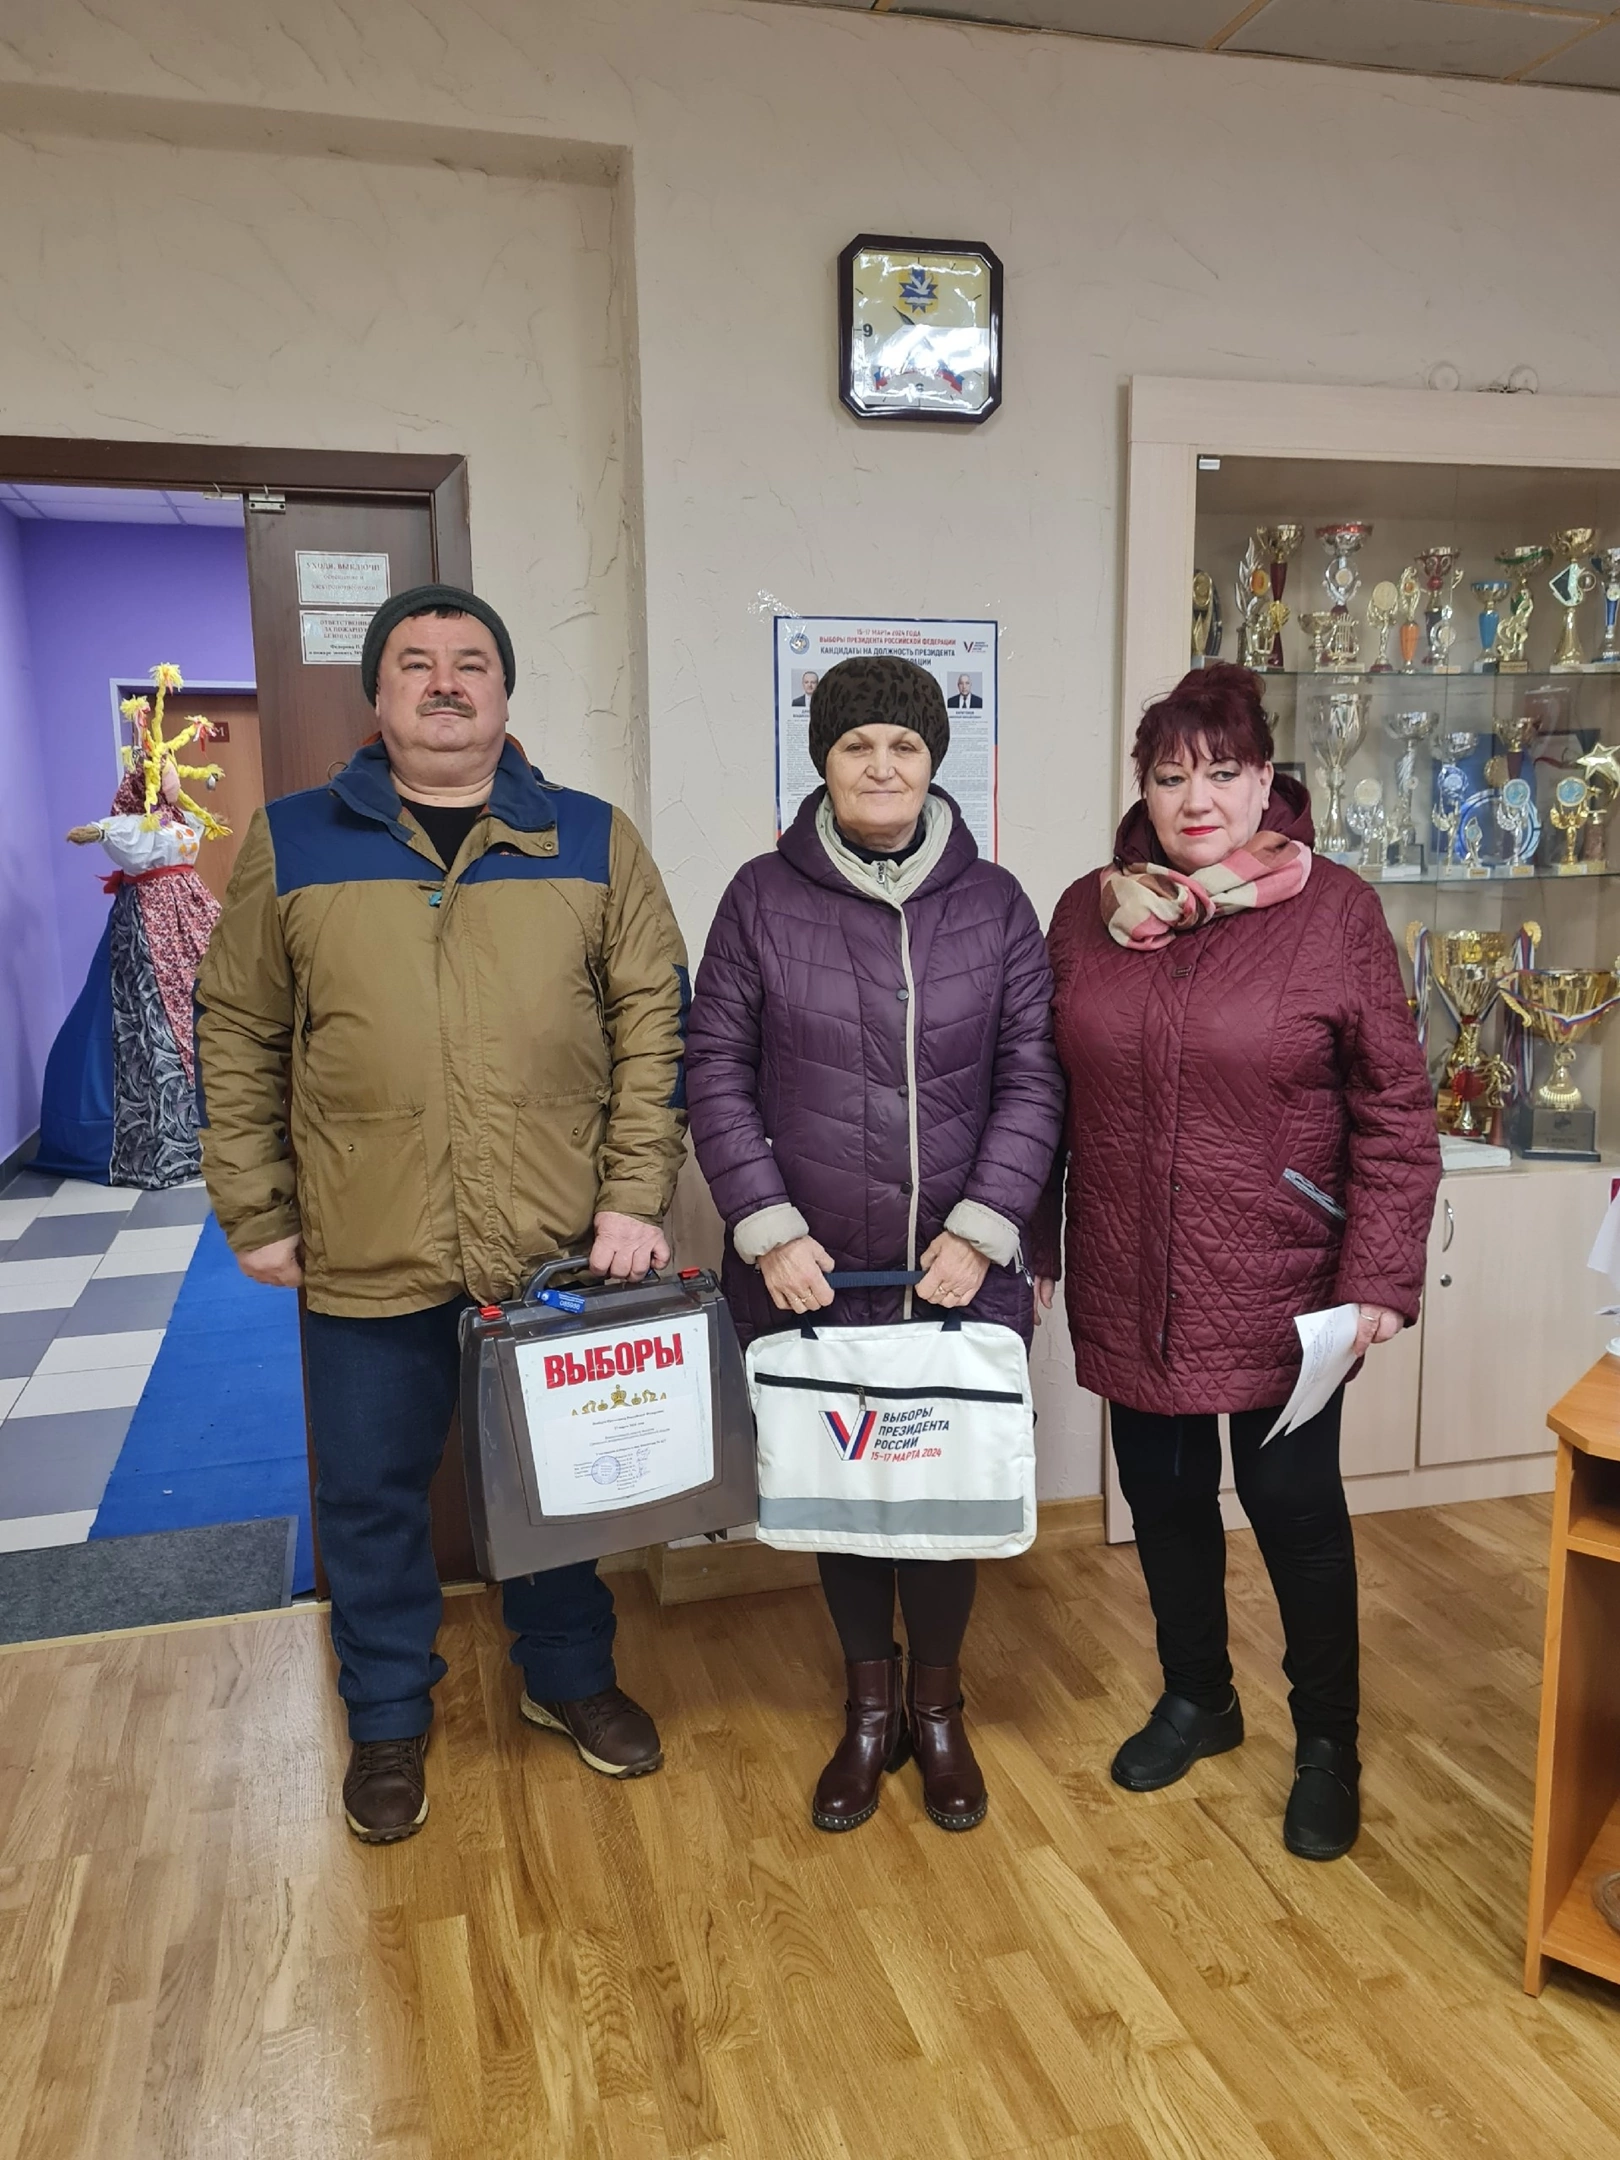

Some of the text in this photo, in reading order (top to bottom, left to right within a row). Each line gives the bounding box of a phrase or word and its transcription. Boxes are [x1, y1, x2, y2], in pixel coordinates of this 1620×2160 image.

[863, 323, 873, 337] 9
[884, 637, 921, 645] РОССИЙСКОЙ
[922, 638, 956, 646] ФЕДЕРАЦИИ
[820, 647, 955, 657] КАНДИДАТЫ НА ДОЛЖНОСТЬ ПРЕЗИДЕНТА
[543, 1333, 684, 1389] ВЫБОРЫ
[882, 1406, 934, 1423] ВЫБОРЫ
[878, 1420, 950, 1437] ПРЕЗИДЕНТА
[874, 1436, 919, 1450] РОССИИ
[892, 1450, 920, 1462] МАРТА
[921, 1448, 942, 1458] 2024
